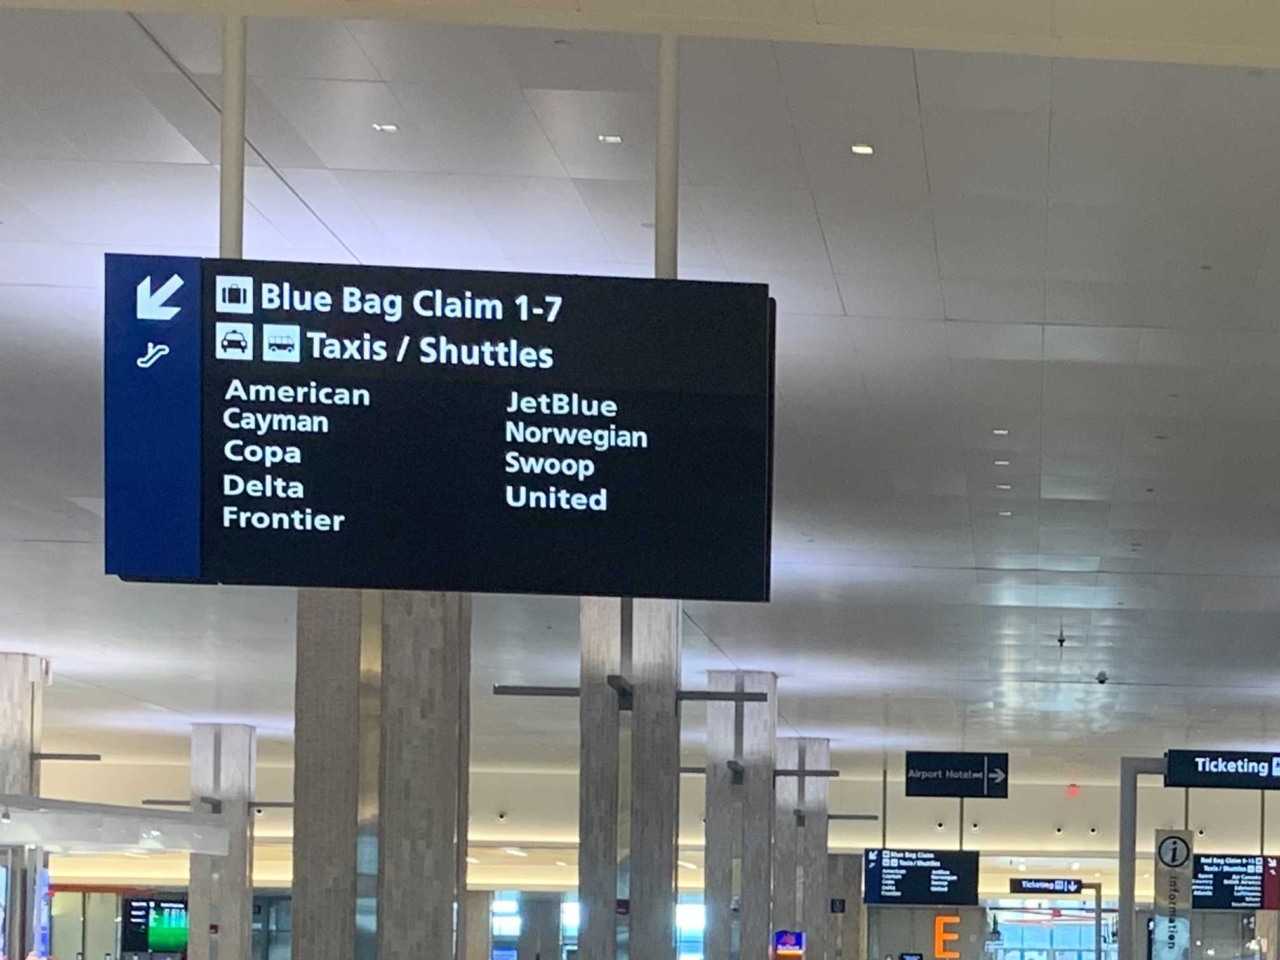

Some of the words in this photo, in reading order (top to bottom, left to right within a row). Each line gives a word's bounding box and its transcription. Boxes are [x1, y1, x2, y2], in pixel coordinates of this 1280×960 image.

[262, 282, 332, 312] Blue
[343, 287, 402, 322] Bag
[413, 289, 502, 319] Claim
[515, 295, 562, 322] 1-7
[307, 332, 387, 361] Taxis
[397, 336, 410, 362] /
[420, 336, 553, 368] Shuttles
[225, 379, 369, 405] American
[507, 392, 617, 416] JetBlue
[223, 408, 328, 435] Cayman
[506, 421, 647, 451] Norwegian
[224, 440, 300, 467] Copa
[506, 452, 594, 481] Swoop
[224, 475, 303, 498] Delta
[506, 486, 606, 510] United
[224, 507, 345, 531] Frontier
[908, 769, 942, 779] Airport
[1195, 758, 1268, 776] Ticketing
[936, 916, 960, 958] E
